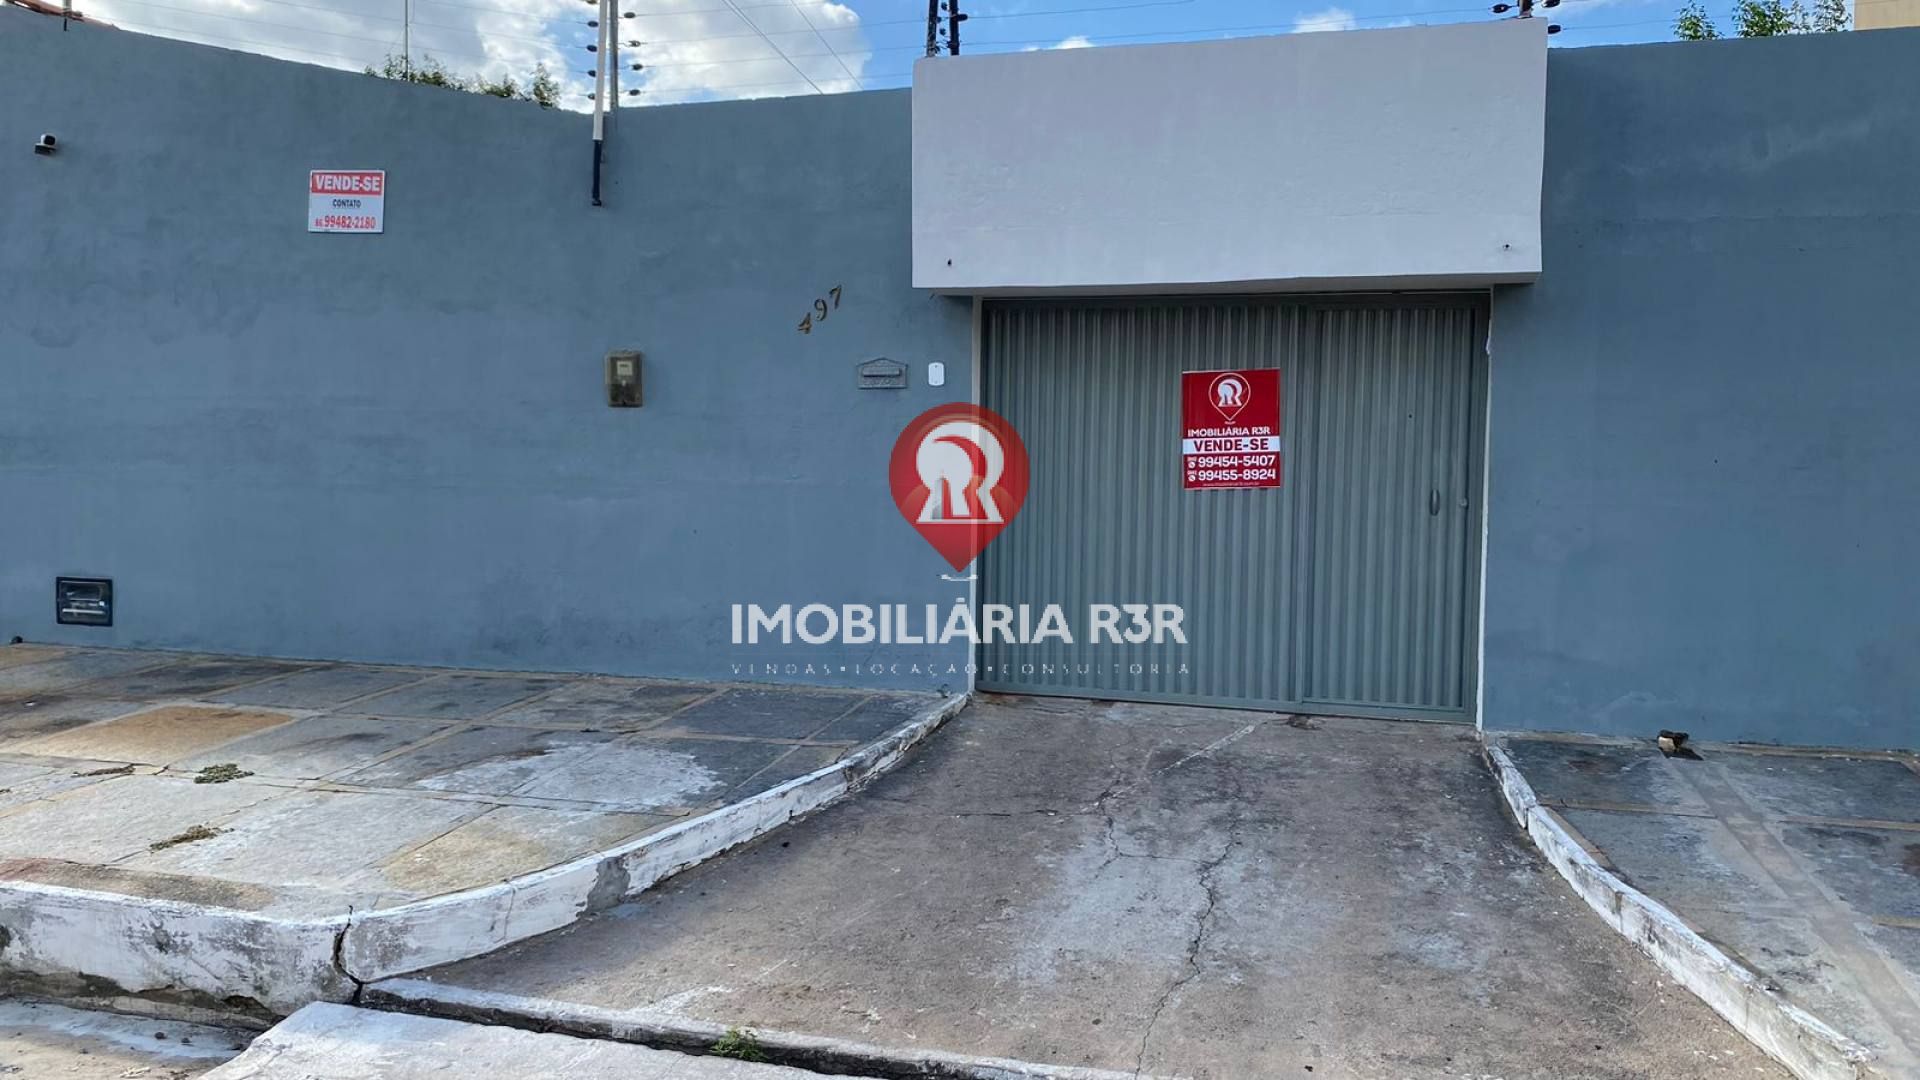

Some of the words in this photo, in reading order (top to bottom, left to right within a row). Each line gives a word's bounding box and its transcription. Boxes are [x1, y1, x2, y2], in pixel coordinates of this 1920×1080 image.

[316, 174, 380, 192] VENDE-SE
[333, 199, 361, 208] CONTATO
[797, 284, 842, 334] 497
[1187, 426, 1249, 437] IMOBILIÁRIA
[1251, 426, 1271, 435] R3R
[1193, 438, 1270, 452] VENDE-SE
[1198, 455, 1276, 468] 99454-5407
[1198, 468, 1276, 481] 99455-8924
